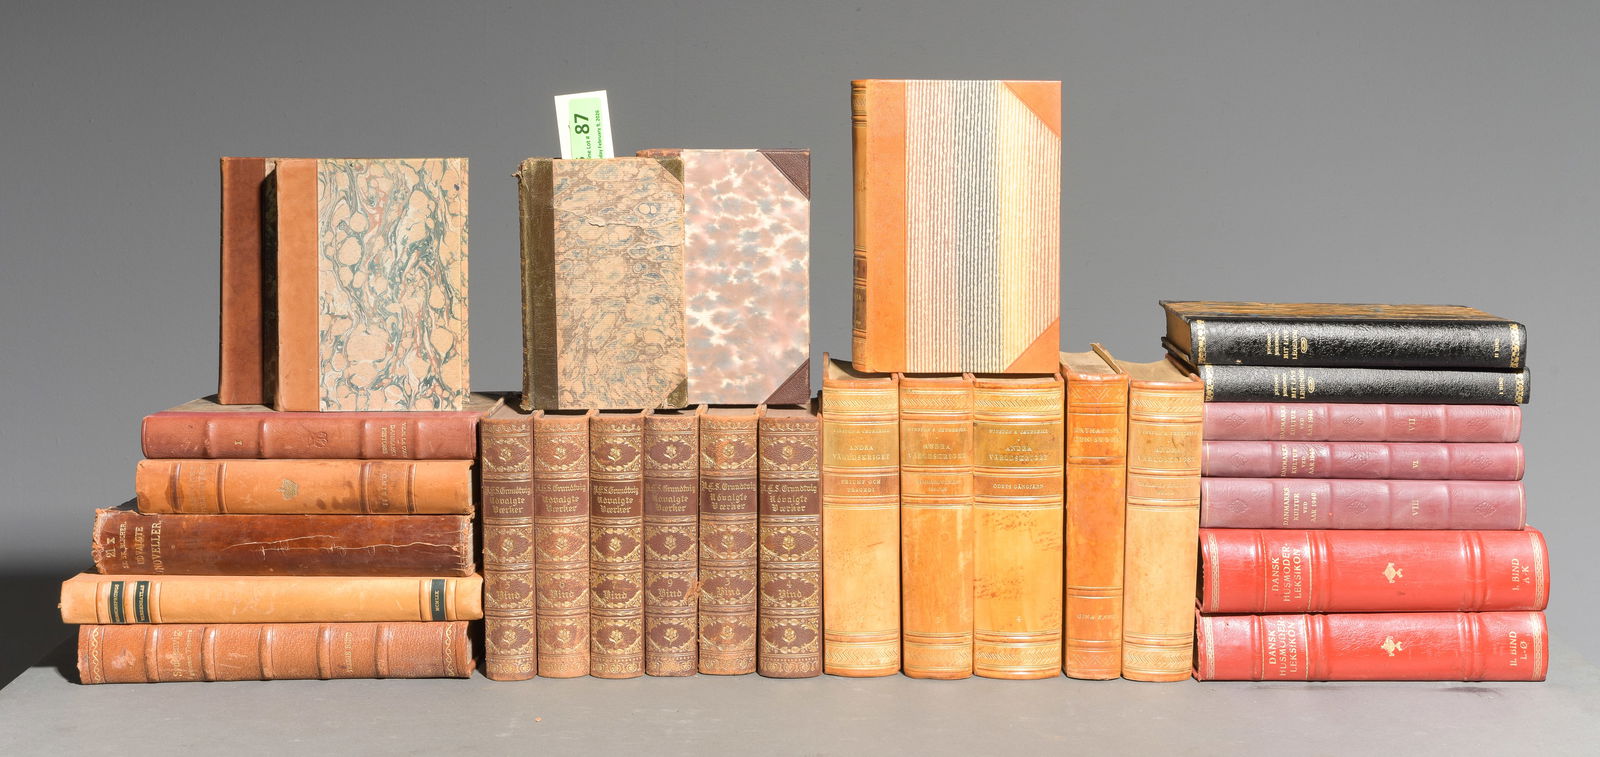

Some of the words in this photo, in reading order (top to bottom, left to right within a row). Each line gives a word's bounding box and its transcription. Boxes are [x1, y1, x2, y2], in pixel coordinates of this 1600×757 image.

[574, 113, 590, 134] 87
[710, 493, 748, 503] Udvalgte
[770, 496, 808, 506] Udvalgte
[1272, 557, 1280, 592] DANSK
[1282, 543, 1290, 602] HUSMODER-
[1293, 548, 1302, 600] LEKSIKON
[496, 590, 520, 600] Bind
[550, 590, 575, 598] Bind
[603, 590, 628, 600] Bind
[658, 588, 682, 598] Bind
[716, 586, 740, 596] Bind
[779, 589, 802, 598] Bind
[1268, 630, 1276, 664] DANSK
[1288, 622, 1297, 673] LEKSIKON
[1508, 630, 1517, 656] BIND
